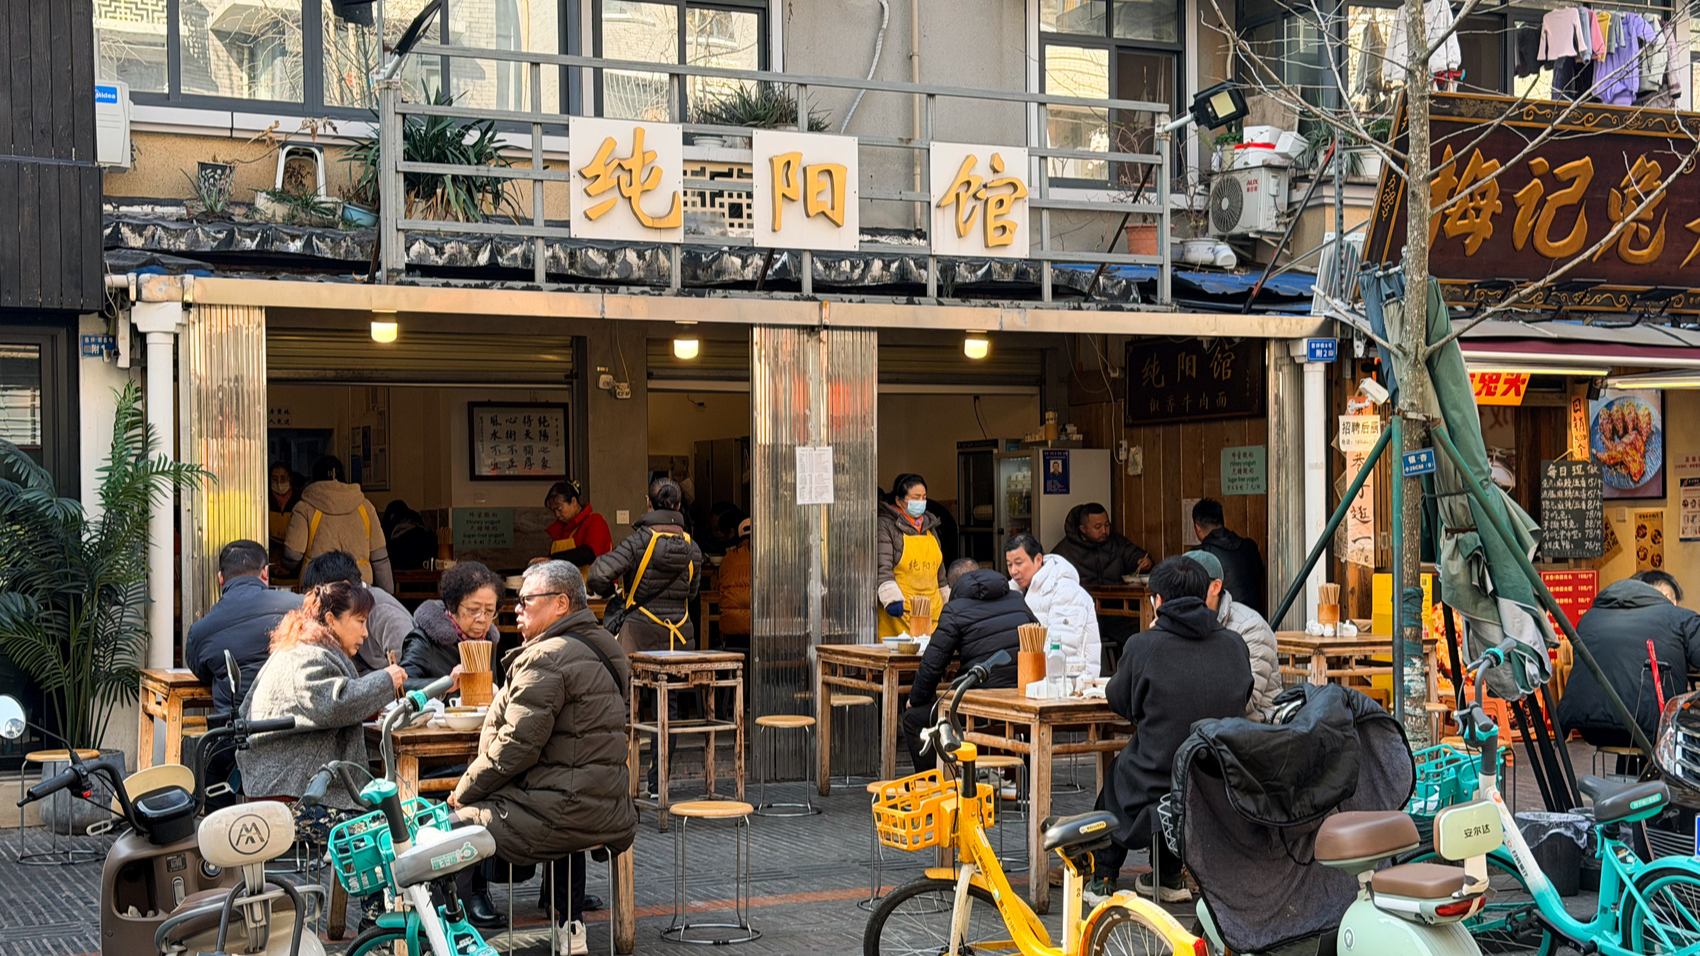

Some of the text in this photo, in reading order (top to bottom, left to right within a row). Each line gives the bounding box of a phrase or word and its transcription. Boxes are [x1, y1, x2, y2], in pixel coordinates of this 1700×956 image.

[578, 126, 1028, 248] 纯阳馆
[1141, 343, 1236, 389] 纯阳馆
[1463, 823, 1491, 839] 安尔达
